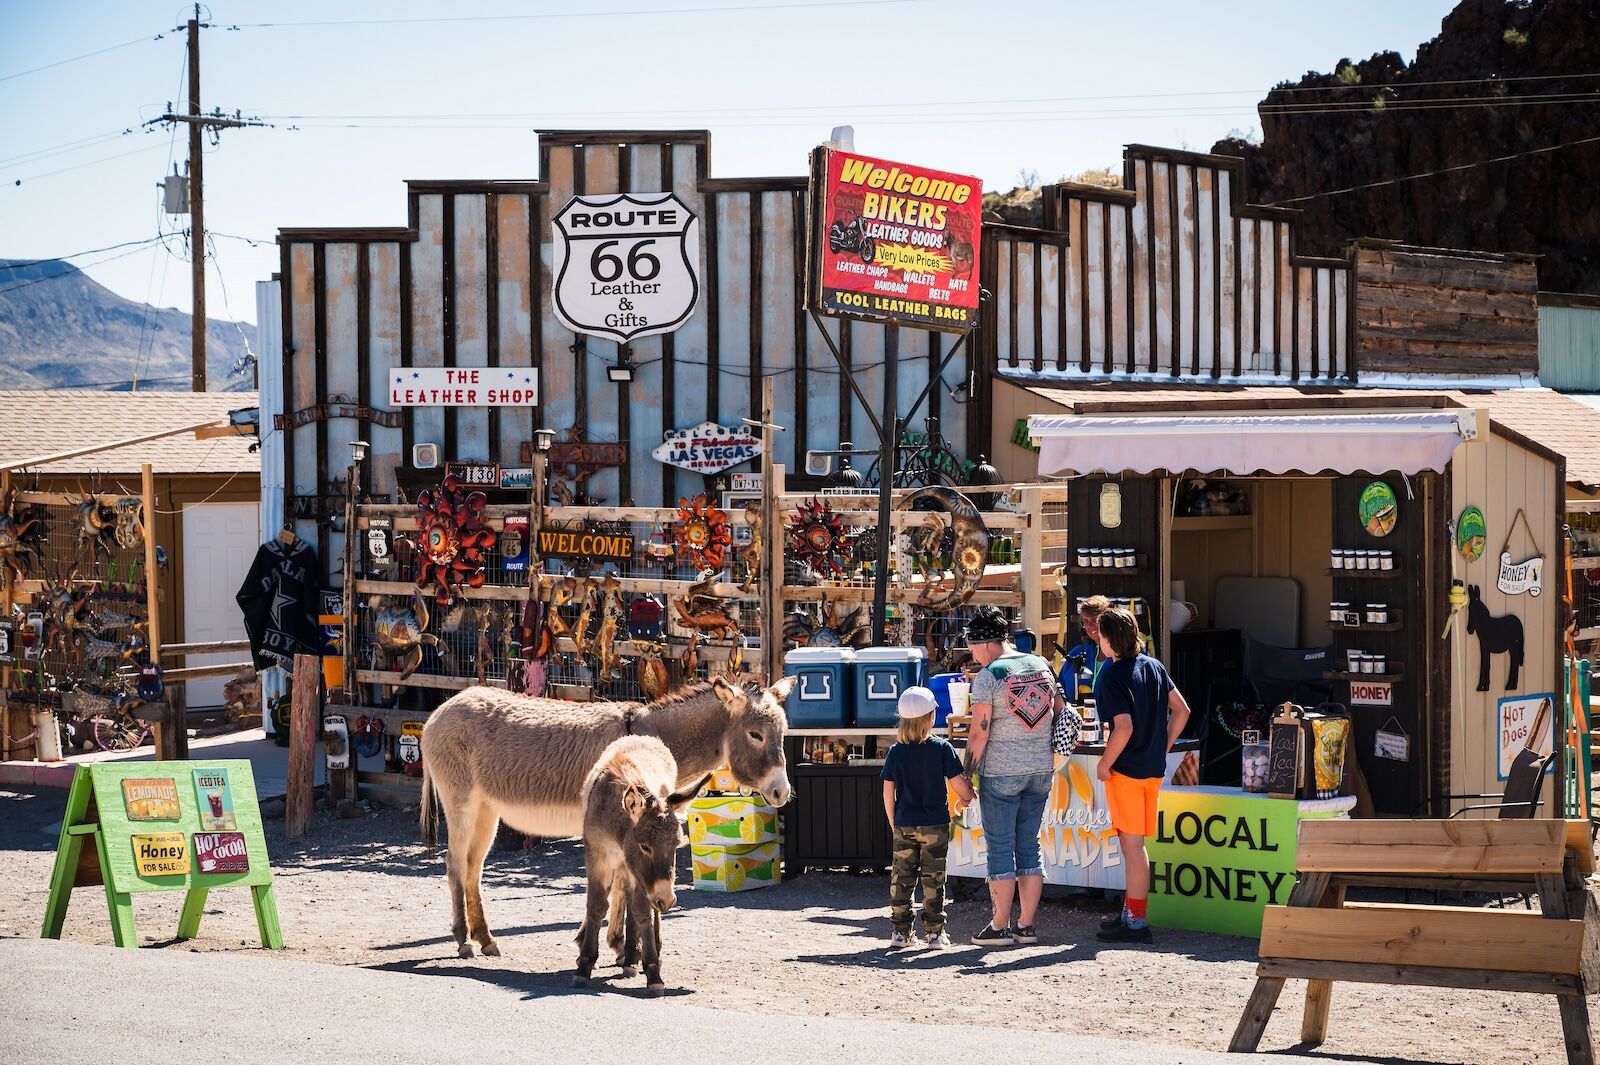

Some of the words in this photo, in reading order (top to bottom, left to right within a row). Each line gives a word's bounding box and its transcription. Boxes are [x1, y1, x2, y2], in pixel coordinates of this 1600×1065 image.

[840, 158, 971, 204] Welcome
[571, 210, 677, 228] ROUTE
[863, 192, 947, 231] BIKERS
[866, 222, 909, 244] LEATHER
[911, 230, 943, 249] GOODS
[590, 239, 661, 282] 66
[880, 248, 898, 261] Very
[899, 251, 914, 263] Low
[916, 255, 940, 269] Prices
[836, 261, 865, 275] LEATHER
[866, 265, 889, 279] CHAPS
[903, 271, 936, 286] WALLETS
[948, 278, 968, 292] HATS
[590, 280, 661, 296] Leather
[874, 280, 909, 294] HANDBAGS
[928, 287, 950, 301] BELTS
[619, 297, 634, 311] &
[835, 291, 869, 308] TOOL
[875, 299, 930, 316] LEATHER
[935, 306, 968, 321] BAGS
[605, 313, 648, 329] Gifts
[446, 370, 479, 385] THE
[392, 390, 477, 403] LEATHER
[487, 389, 534, 403] SHOP
[666, 426, 750, 439] WELCOME
[690, 436, 759, 449] Fabulous
[670, 448, 698, 462] LAS
[702, 445, 754, 460] VEGAS
[690, 460, 729, 468] NEVADA
[505, 516, 528, 524] HISTORIC
[374, 544, 383, 554] 66
[506, 545, 516, 556] 66
[540, 532, 632, 557] WELCOME
[506, 562, 523, 570] ROUTE
[1501, 564, 1530, 582] HONEY
[1501, 582, 1511, 590] FOR
[1511, 583, 1526, 591] SALE
[1352, 687, 1391, 700] HONEY
[1503, 706, 1525, 728] HOT
[1272, 728, 1295, 751] Iced
[1503, 726, 1528, 749] DOGS
[405, 750, 415, 762] 66
[1271, 751, 1294, 770] Tea
[198, 777, 213, 787] ICED
[213, 777, 226, 787] TEA
[127, 786, 175, 802] LEMONADE
[1156, 810, 1279, 852] LOCAL
[140, 844, 184, 860] Honey
[194, 834, 221, 855] HOT
[213, 839, 246, 859] COCOA
[953, 827, 1121, 870] LENADE
[143, 864, 157, 872] FOR
[158, 863, 176, 871] SALE
[1148, 861, 1287, 904] HONEY
